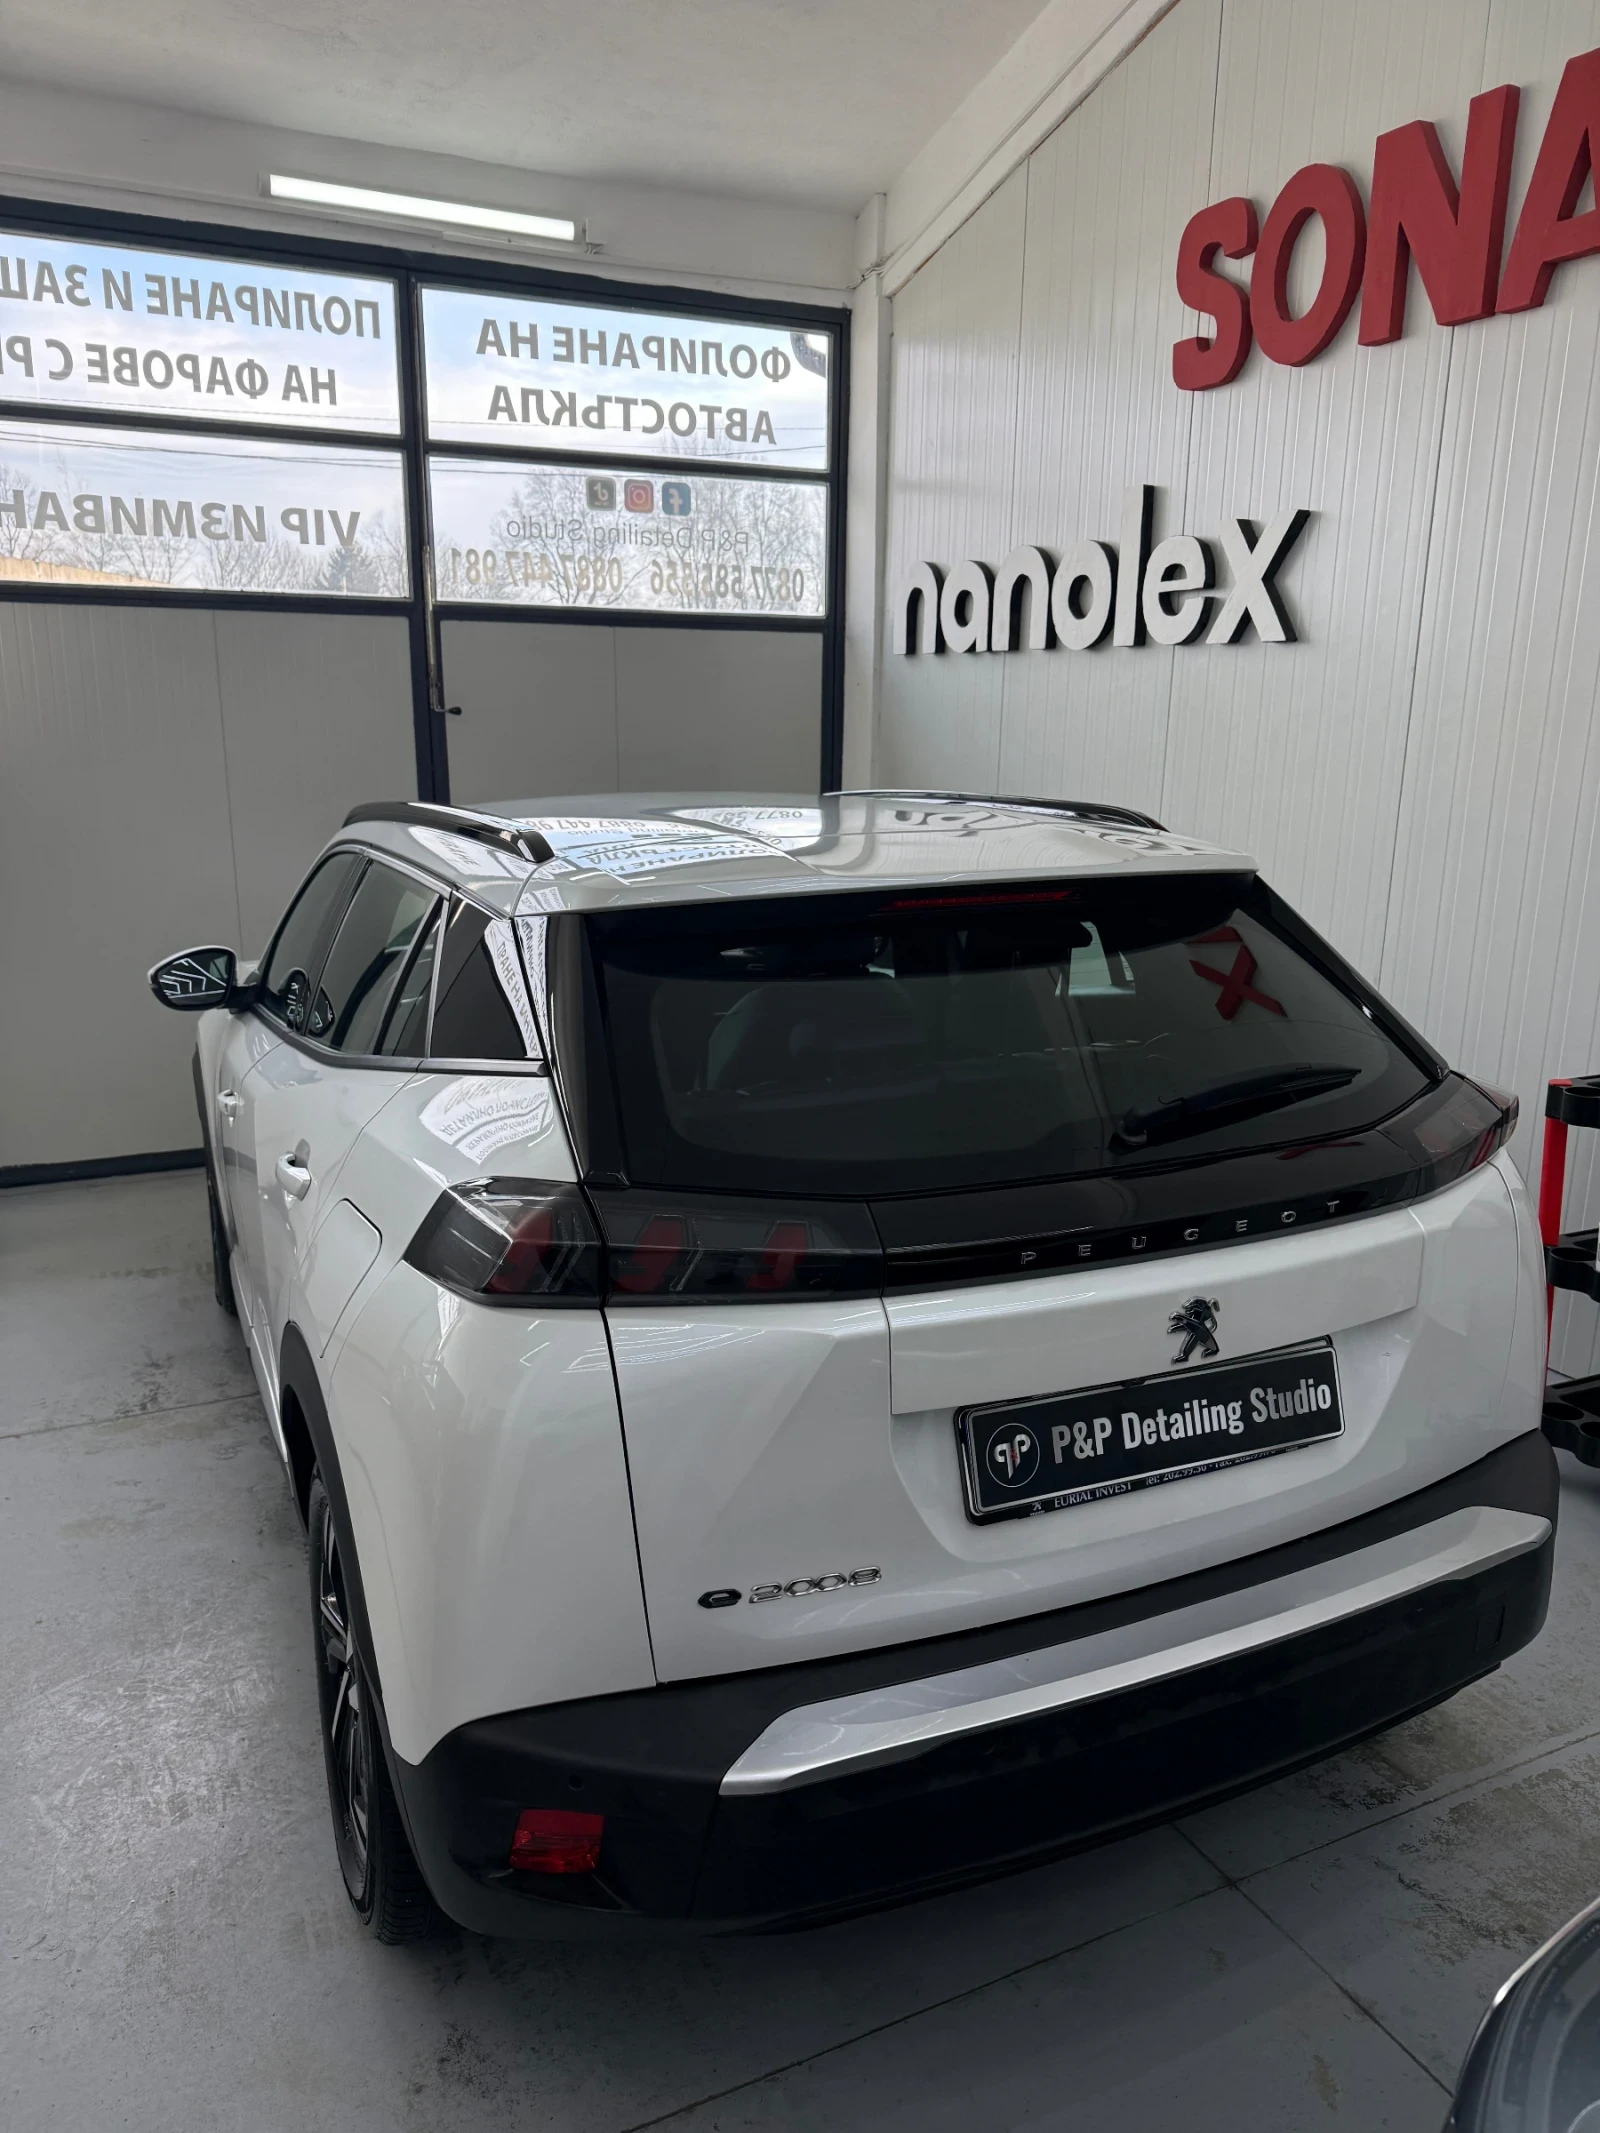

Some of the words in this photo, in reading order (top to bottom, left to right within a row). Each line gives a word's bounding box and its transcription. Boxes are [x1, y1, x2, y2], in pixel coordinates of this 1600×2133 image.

[1173, 47, 1600, 391] SONA
[893, 484, 1310, 655] nanolex
[1020, 1200, 1340, 1265] PEUGEOT
[1051, 1417, 1112, 1464] P&P
[1122, 1398, 1244, 1450] Detailing
[1250, 1379, 1332, 1424] Studio
[1054, 1488, 1094, 1508] EURIAL
[1096, 1481, 1132, 1499] INVEST
[749, 1566, 882, 1604] 2008
